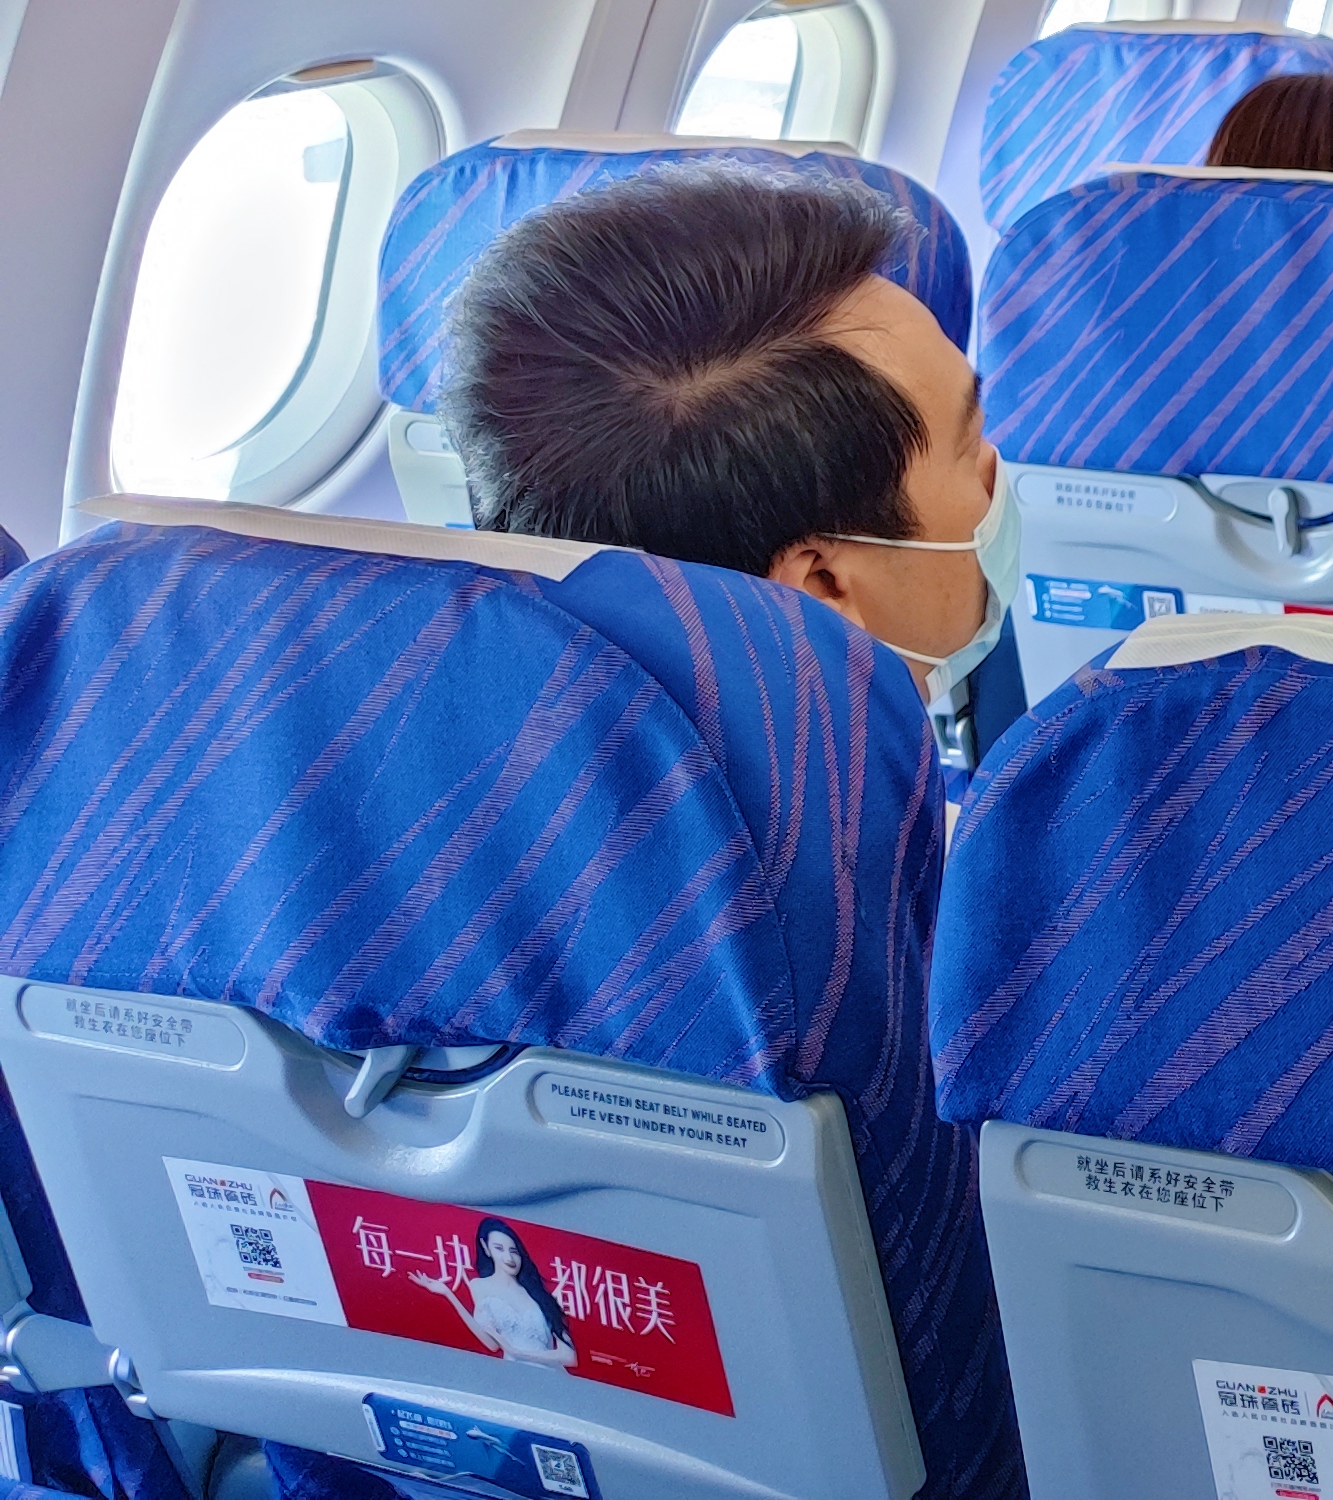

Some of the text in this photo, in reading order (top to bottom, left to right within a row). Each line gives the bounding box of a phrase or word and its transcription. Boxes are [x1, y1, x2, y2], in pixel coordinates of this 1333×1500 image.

[74, 1015, 186, 1047] 救生衣在您座位下
[551, 1083, 767, 1133] PLEASE FASTEN SEAT BELT WHILE SEATED
[571, 1106, 747, 1148] LIFE VEST UNDER YOUR SEAT
[1076, 1155, 1235, 1197] 就坐后请系好安全带
[1085, 1174, 1225, 1212] 救生衣在您座位下
[352, 1215, 677, 1345] 每一块 都很美
[1218, 1391, 1300, 1416] 冠珠瓷砖
